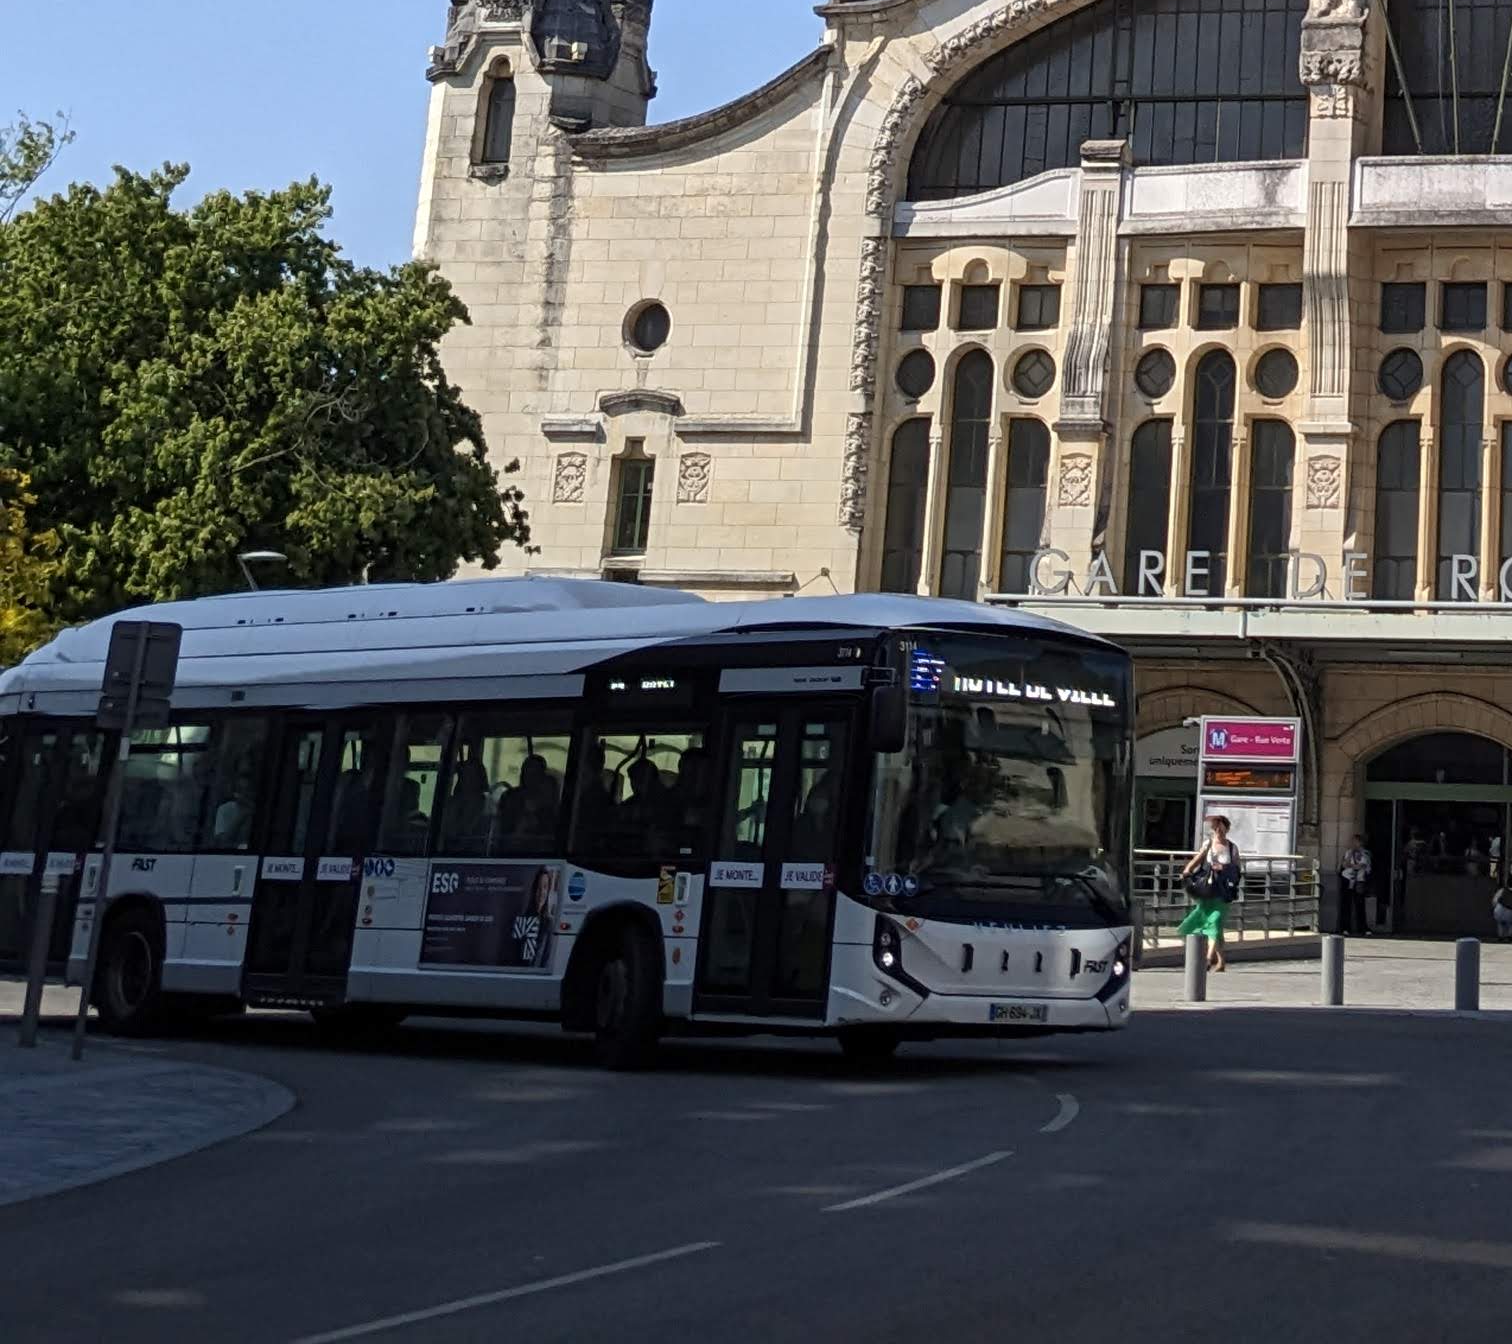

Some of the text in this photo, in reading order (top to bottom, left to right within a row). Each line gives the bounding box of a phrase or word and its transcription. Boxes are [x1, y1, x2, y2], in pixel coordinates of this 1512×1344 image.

[1029, 547, 1210, 597] GARE
[1292, 551, 1368, 600] DE
[1212, 730, 1226, 746] M
[1230, 734, 1249, 744] Gare
[1255, 735, 1270, 744] Rue
[714, 869, 724, 881] JE
[784, 870, 794, 882] JE
[431, 872, 460, 894] ESG
